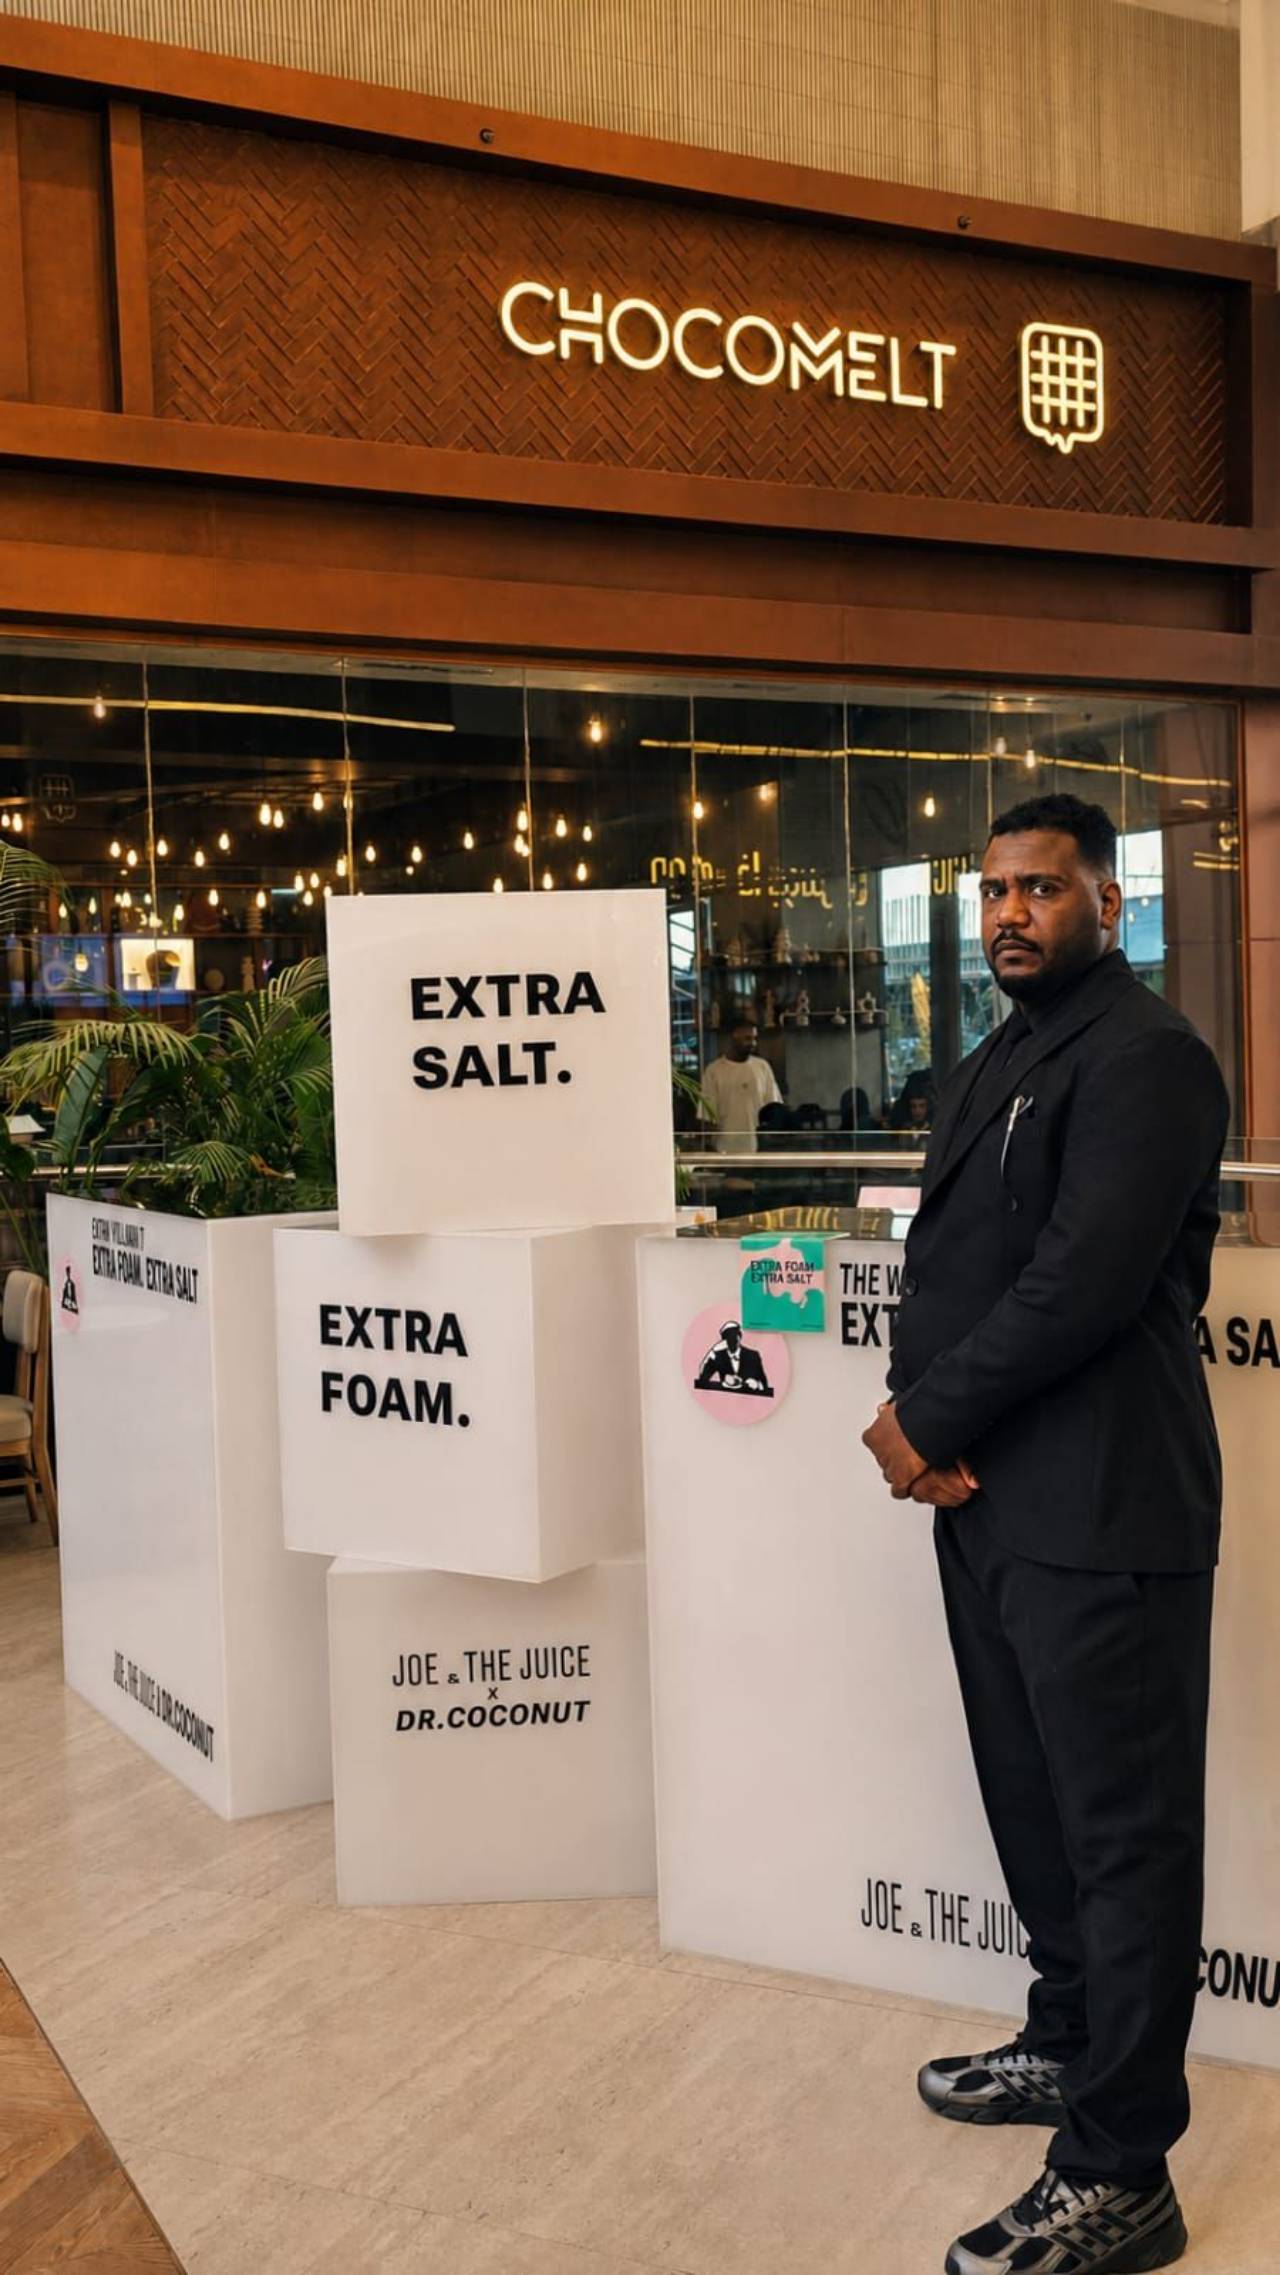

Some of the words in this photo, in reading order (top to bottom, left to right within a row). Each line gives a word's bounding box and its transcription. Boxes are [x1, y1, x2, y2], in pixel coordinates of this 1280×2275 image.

[501, 281, 957, 409] CHOCOMELT
[410, 971, 606, 1021] EXTRA
[412, 1041, 573, 1090] SALT.
[93, 1245, 117, 1280] EXTRA
[146, 1257, 175, 1297] EXTRA
[176, 1264, 198, 1303] SALT
[750, 1260, 783, 1273] EXTRA
[784, 1260, 815, 1273] FOAM
[751, 1272, 785, 1285] EXTRA
[786, 1273, 814, 1285] SALT
[839, 1262, 880, 1296] THE
[319, 1304, 469, 1358] EXTRA
[840, 1302, 900, 1349] EXT
[1226, 1315, 1280, 1369] SA
[321, 1370, 471, 1428] FOAM.
[392, 1653, 439, 1687] JOE
[447, 1672, 460, 1684] &
[463, 1649, 512, 1683] THE
[520, 1645, 591, 1680] JUICE
[395, 1701, 591, 1732] DR.COCONUT
[861, 1878, 904, 1934] JOE
[910, 1921, 923, 1938] &
[924, 1888, 971, 1948] THE
[977, 1899, 1031, 1959] JUIC
